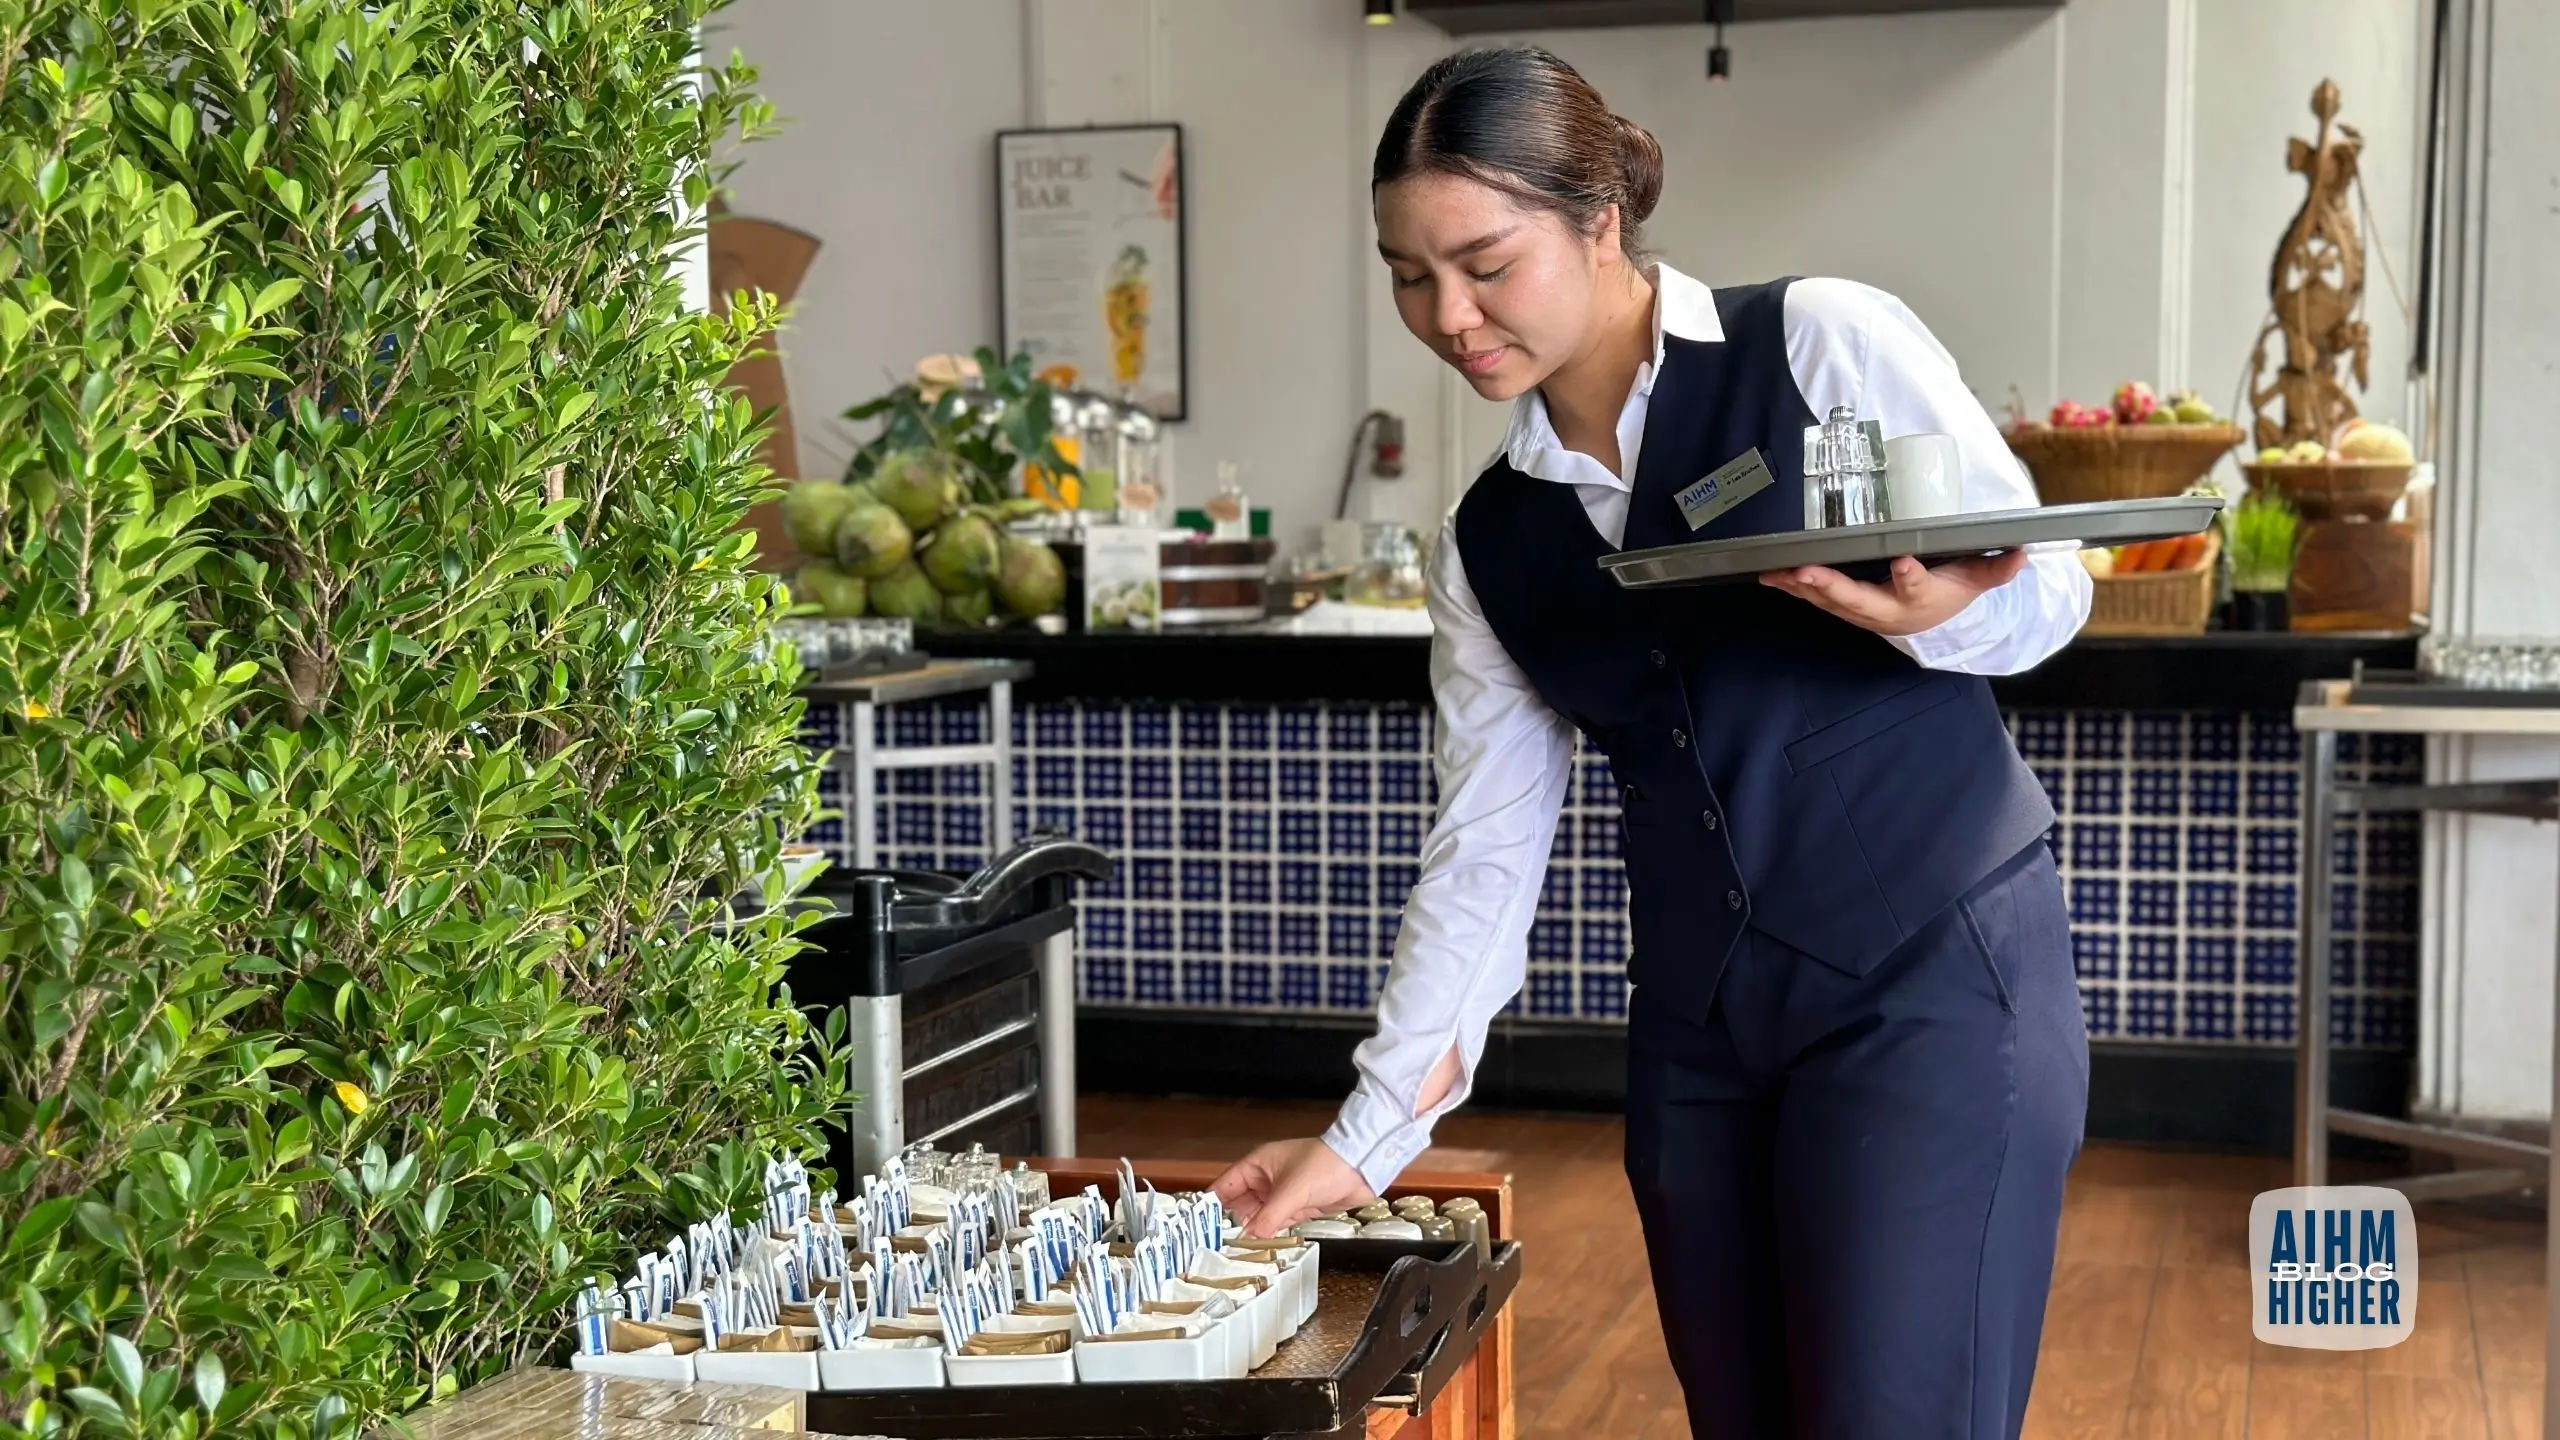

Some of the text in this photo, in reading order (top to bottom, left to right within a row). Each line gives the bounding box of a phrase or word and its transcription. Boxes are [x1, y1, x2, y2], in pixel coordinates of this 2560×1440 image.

[1013, 155, 1092, 185] JUICE
[1017, 185, 1073, 209] BAR
[1683, 480, 1718, 507] AIHM
